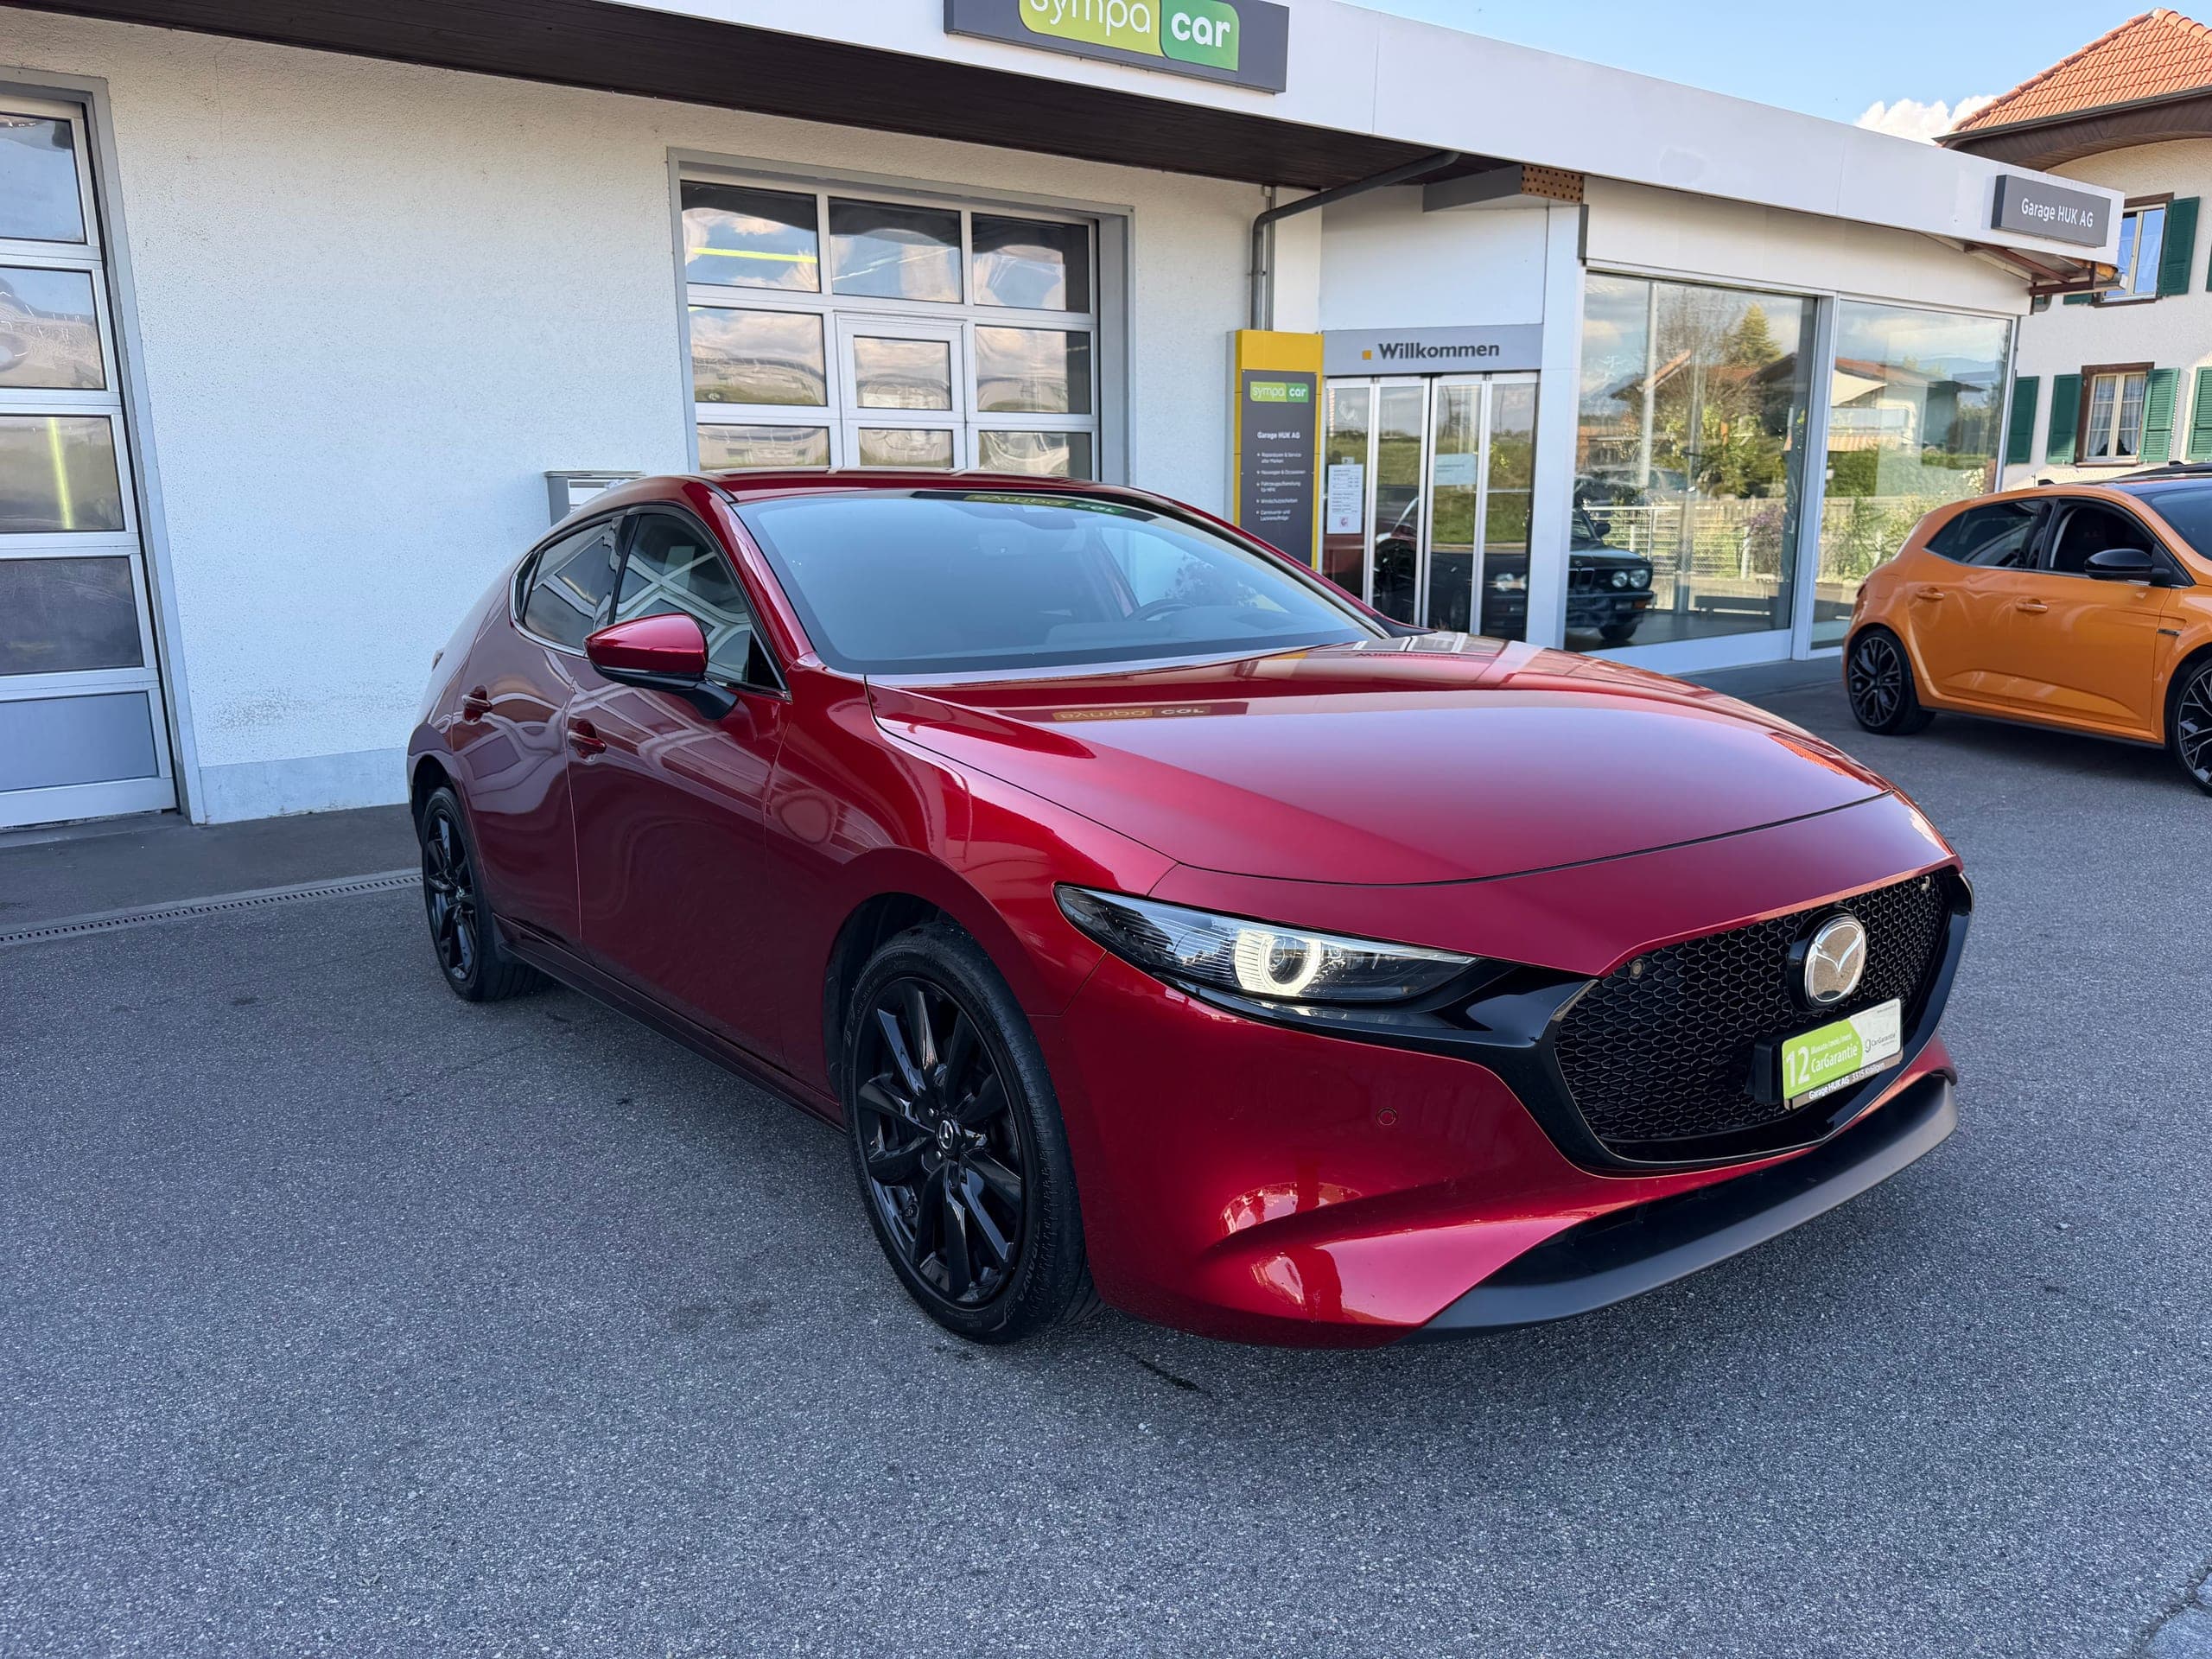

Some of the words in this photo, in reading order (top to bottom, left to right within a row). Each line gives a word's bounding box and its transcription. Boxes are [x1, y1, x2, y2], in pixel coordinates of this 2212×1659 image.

[1171, 12, 1231, 48] car
[2020, 198, 2056, 222] Garage
[2057, 205, 2079, 226] HUK
[2079, 210, 2094, 228] AG
[1377, 342, 1500, 360] Willkommen
[1252, 386, 1285, 399] sympa
[1288, 387, 1307, 397] car
[1256, 431, 1277, 440] Garage
[1786, 1046, 1811, 1088] 12
[1811, 1042, 1858, 1073] CarGarantie
[1808, 1085, 1828, 1100] Garage
[1840, 1075, 1850, 1086] AG
